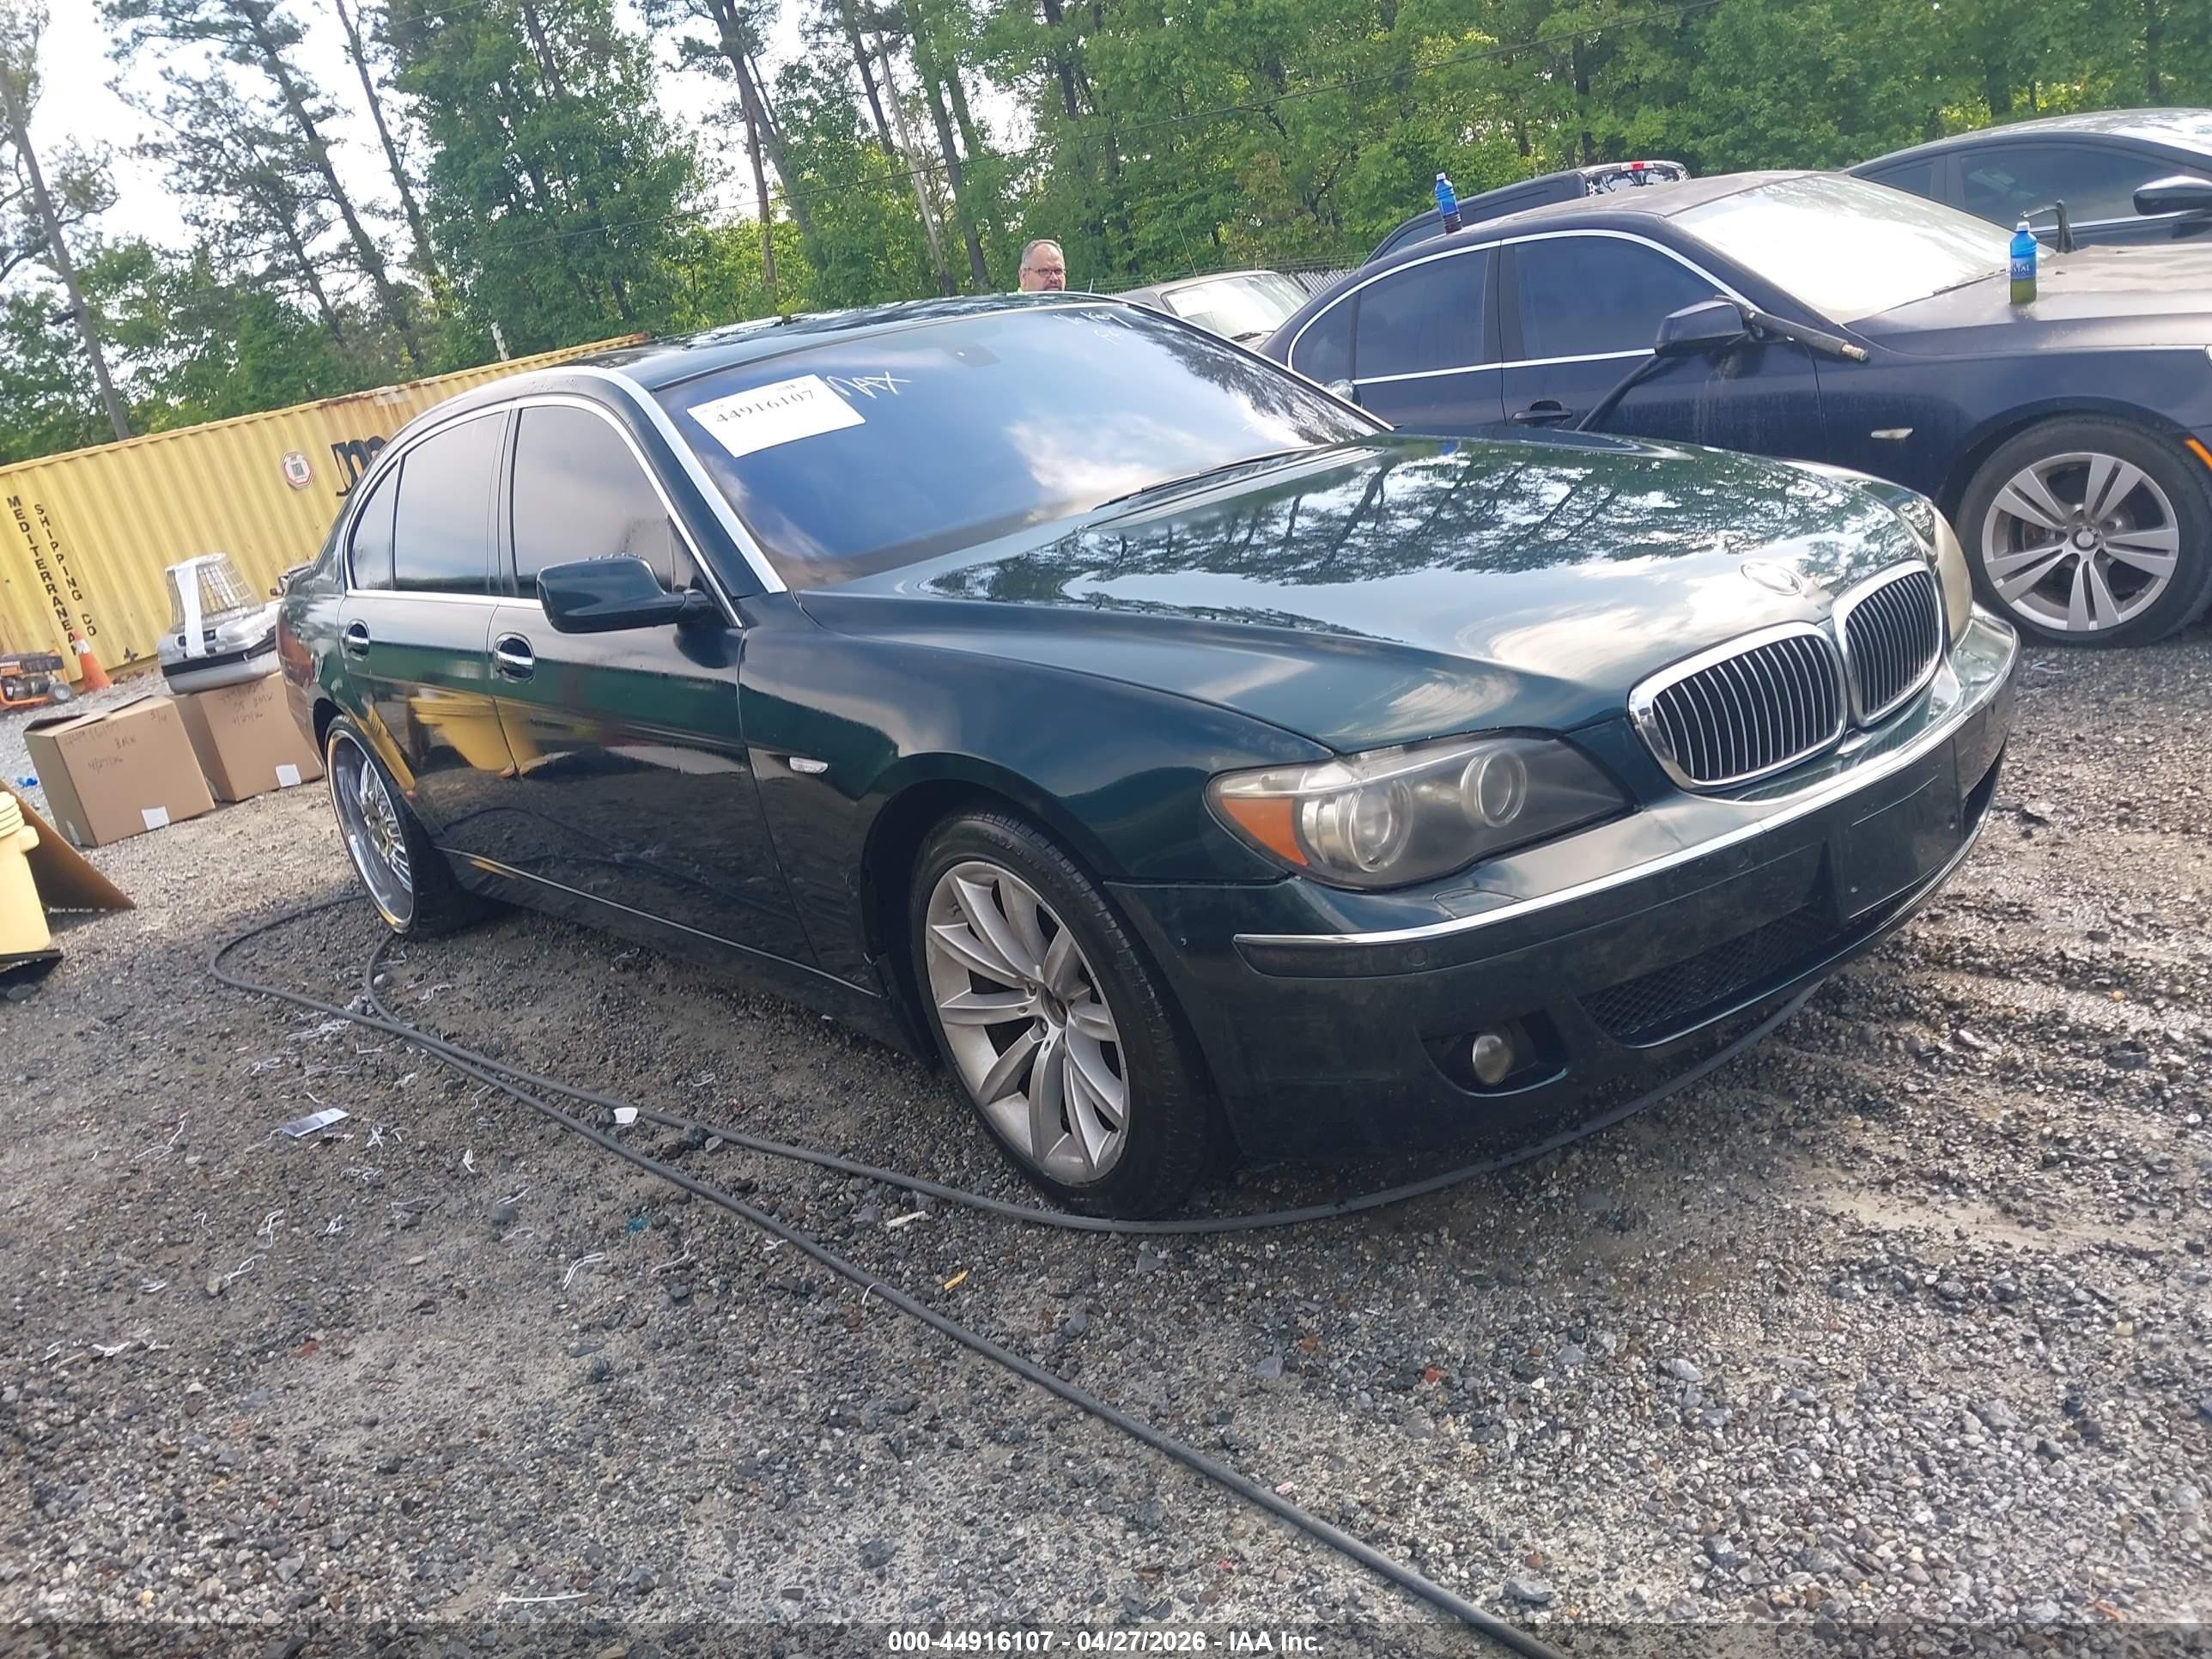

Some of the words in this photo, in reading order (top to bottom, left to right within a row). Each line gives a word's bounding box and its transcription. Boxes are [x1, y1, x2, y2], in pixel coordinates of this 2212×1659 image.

[716, 390, 816, 423] 44916107
[34, 504, 83, 601] SHIPPING
[82, 614, 97, 636] CO
